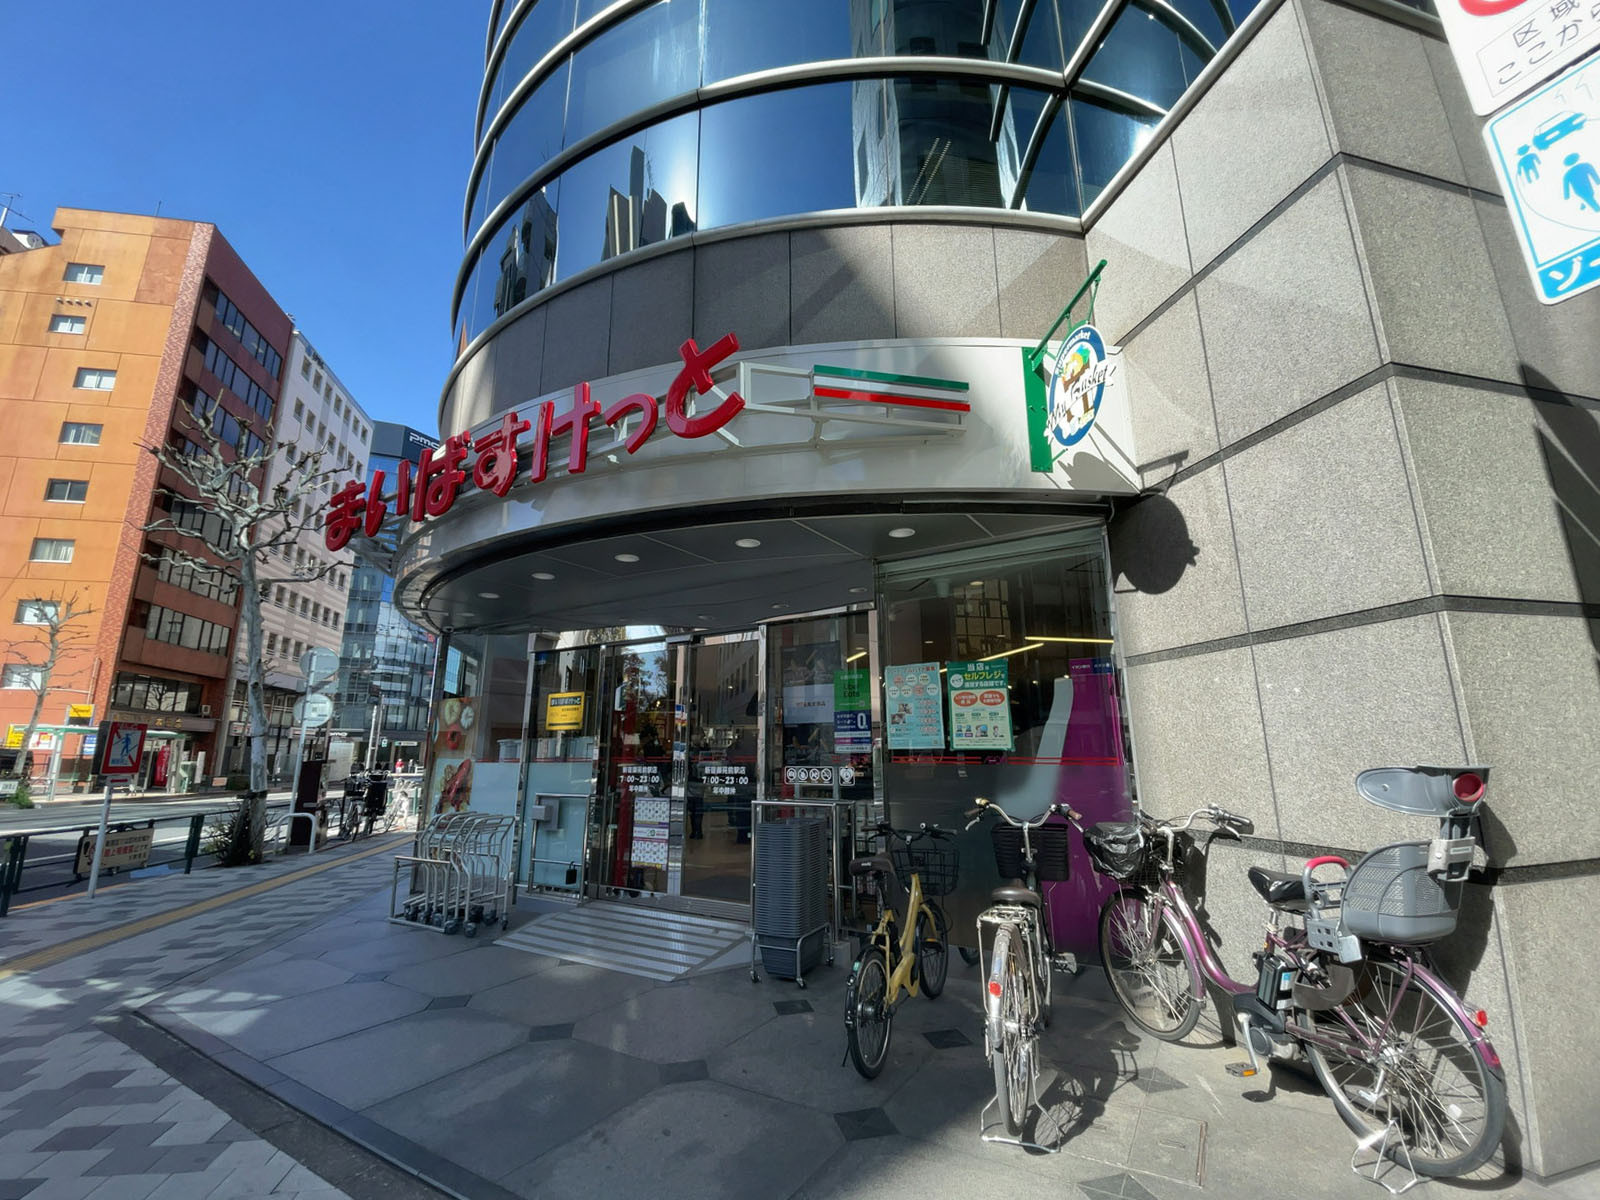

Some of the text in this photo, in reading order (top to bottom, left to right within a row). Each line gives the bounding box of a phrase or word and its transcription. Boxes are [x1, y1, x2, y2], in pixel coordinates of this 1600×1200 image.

[1512, 0, 1580, 48] 区域
[325, 332, 746, 552] まいばすけっと
